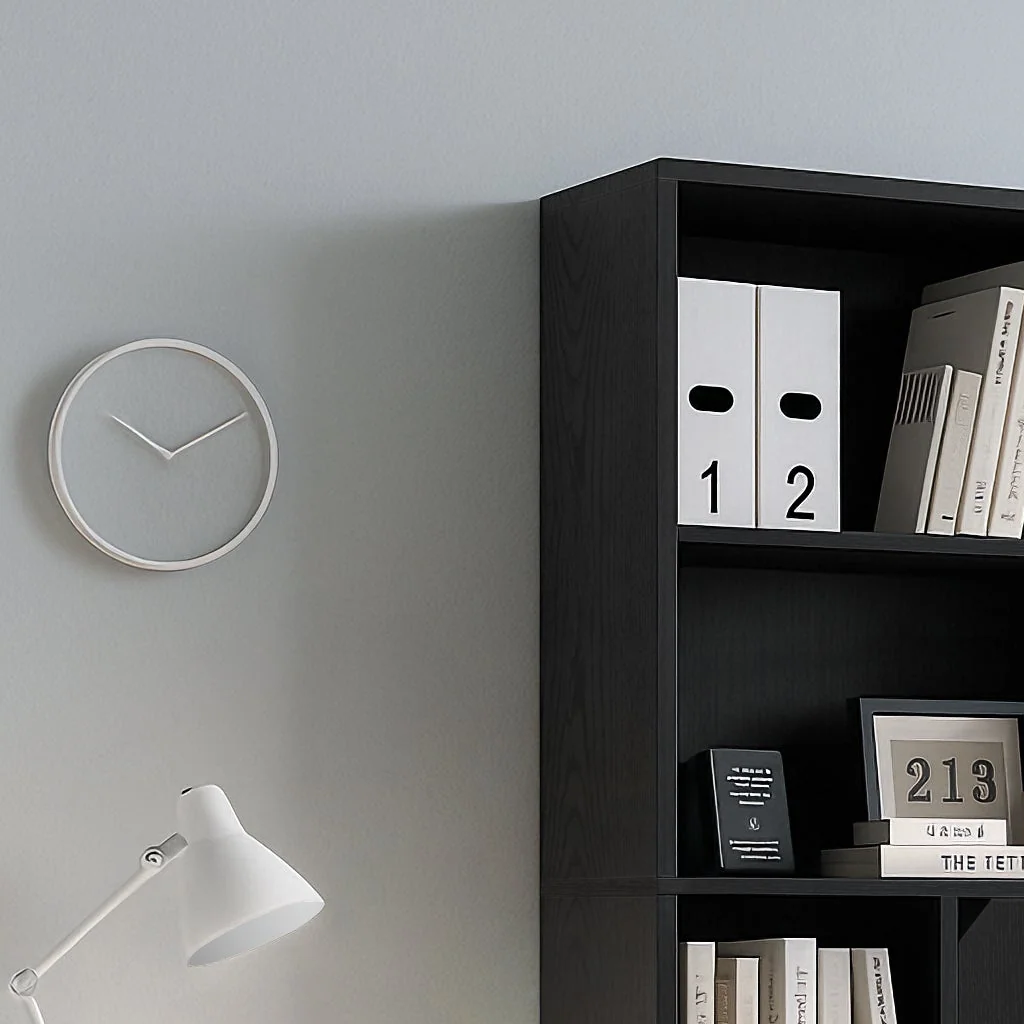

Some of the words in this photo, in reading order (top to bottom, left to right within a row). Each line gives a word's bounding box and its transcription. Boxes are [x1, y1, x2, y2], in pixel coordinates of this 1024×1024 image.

[701, 460, 718, 513] 1
[786, 465, 815, 520] 2
[906, 757, 997, 803] 213
[941, 855, 976, 870] THE
